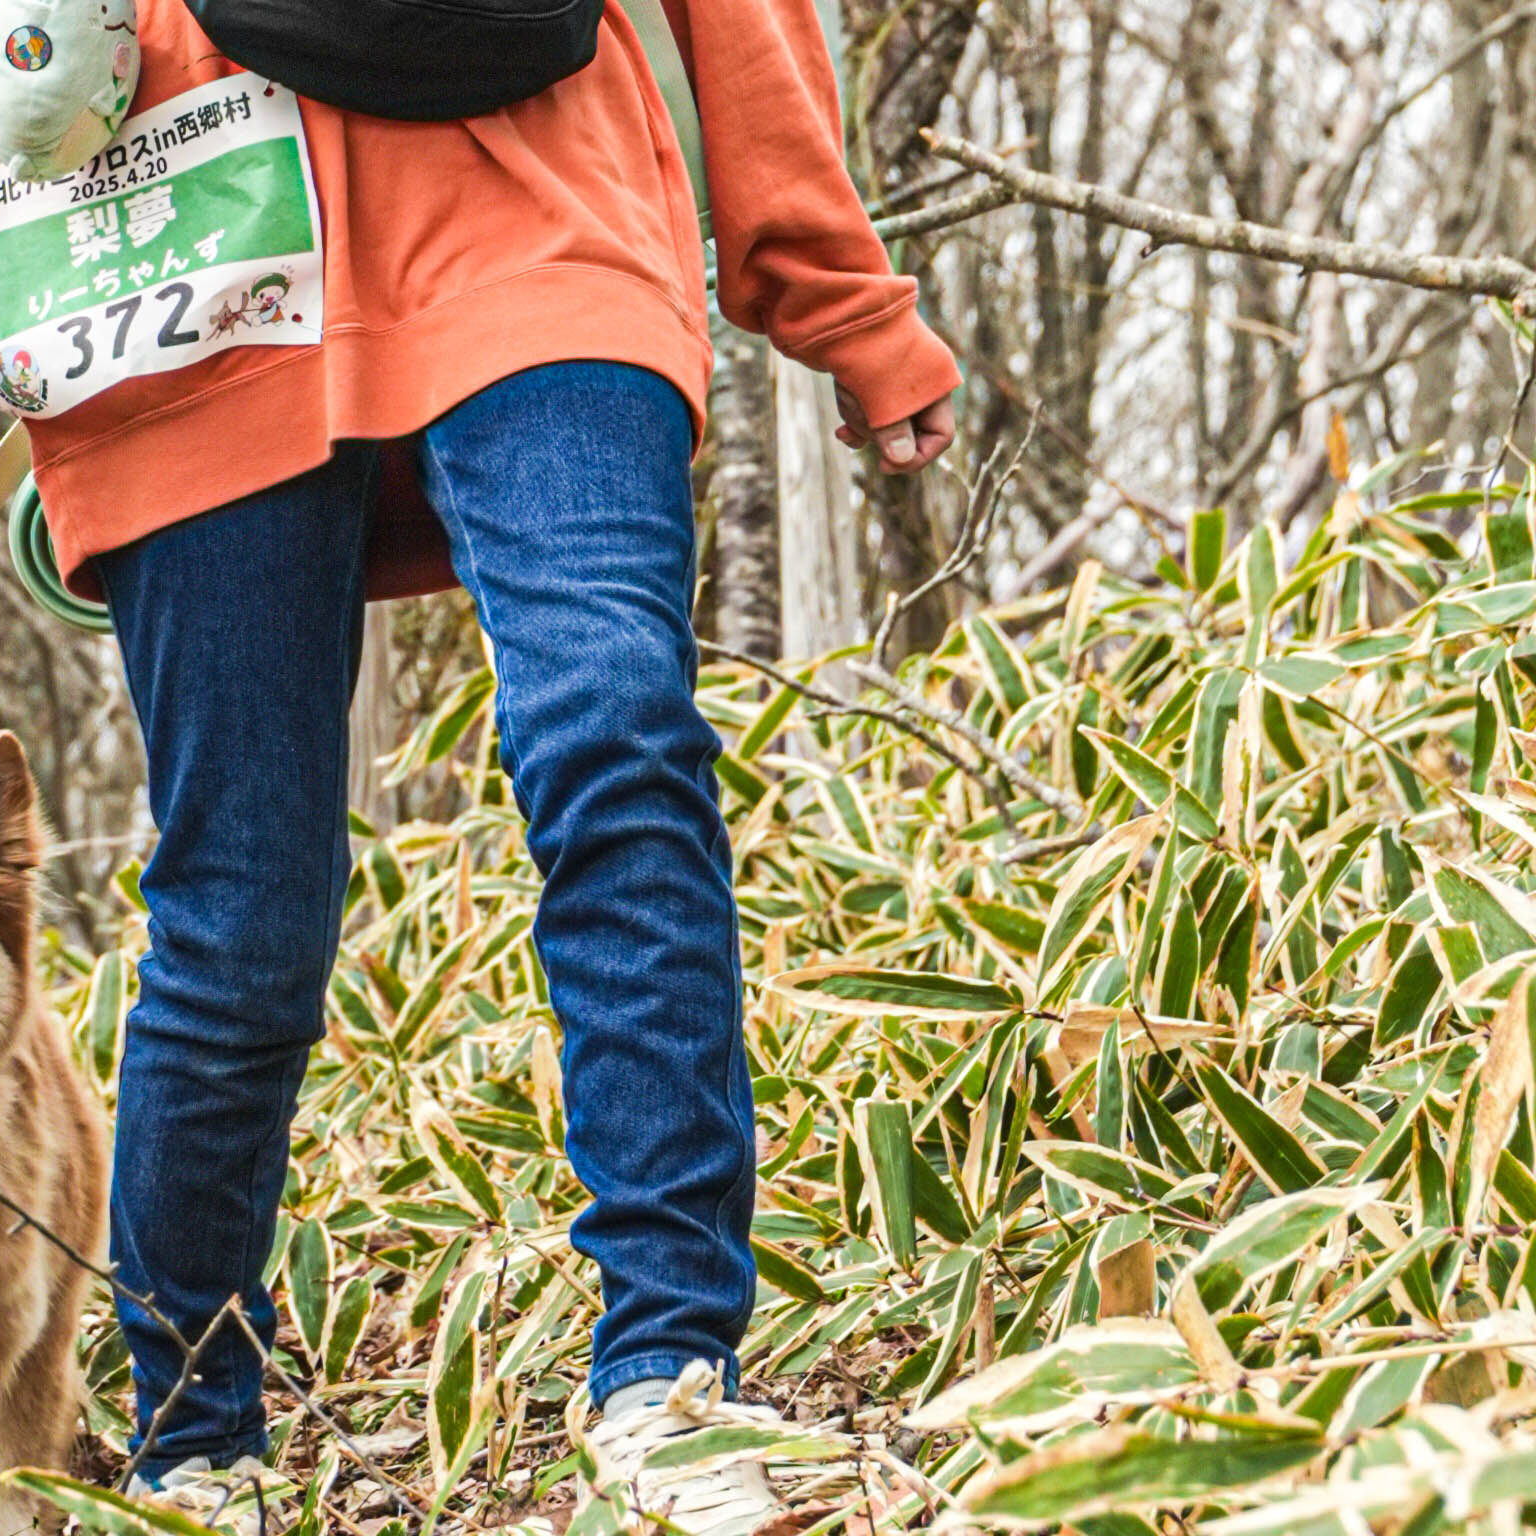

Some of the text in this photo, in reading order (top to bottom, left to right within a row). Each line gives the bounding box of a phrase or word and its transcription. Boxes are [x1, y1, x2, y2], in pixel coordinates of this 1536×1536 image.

[70, 157, 168, 204] 2025.4.20
[67, 184, 177, 268] 梨夢
[57, 281, 201, 381] 372
